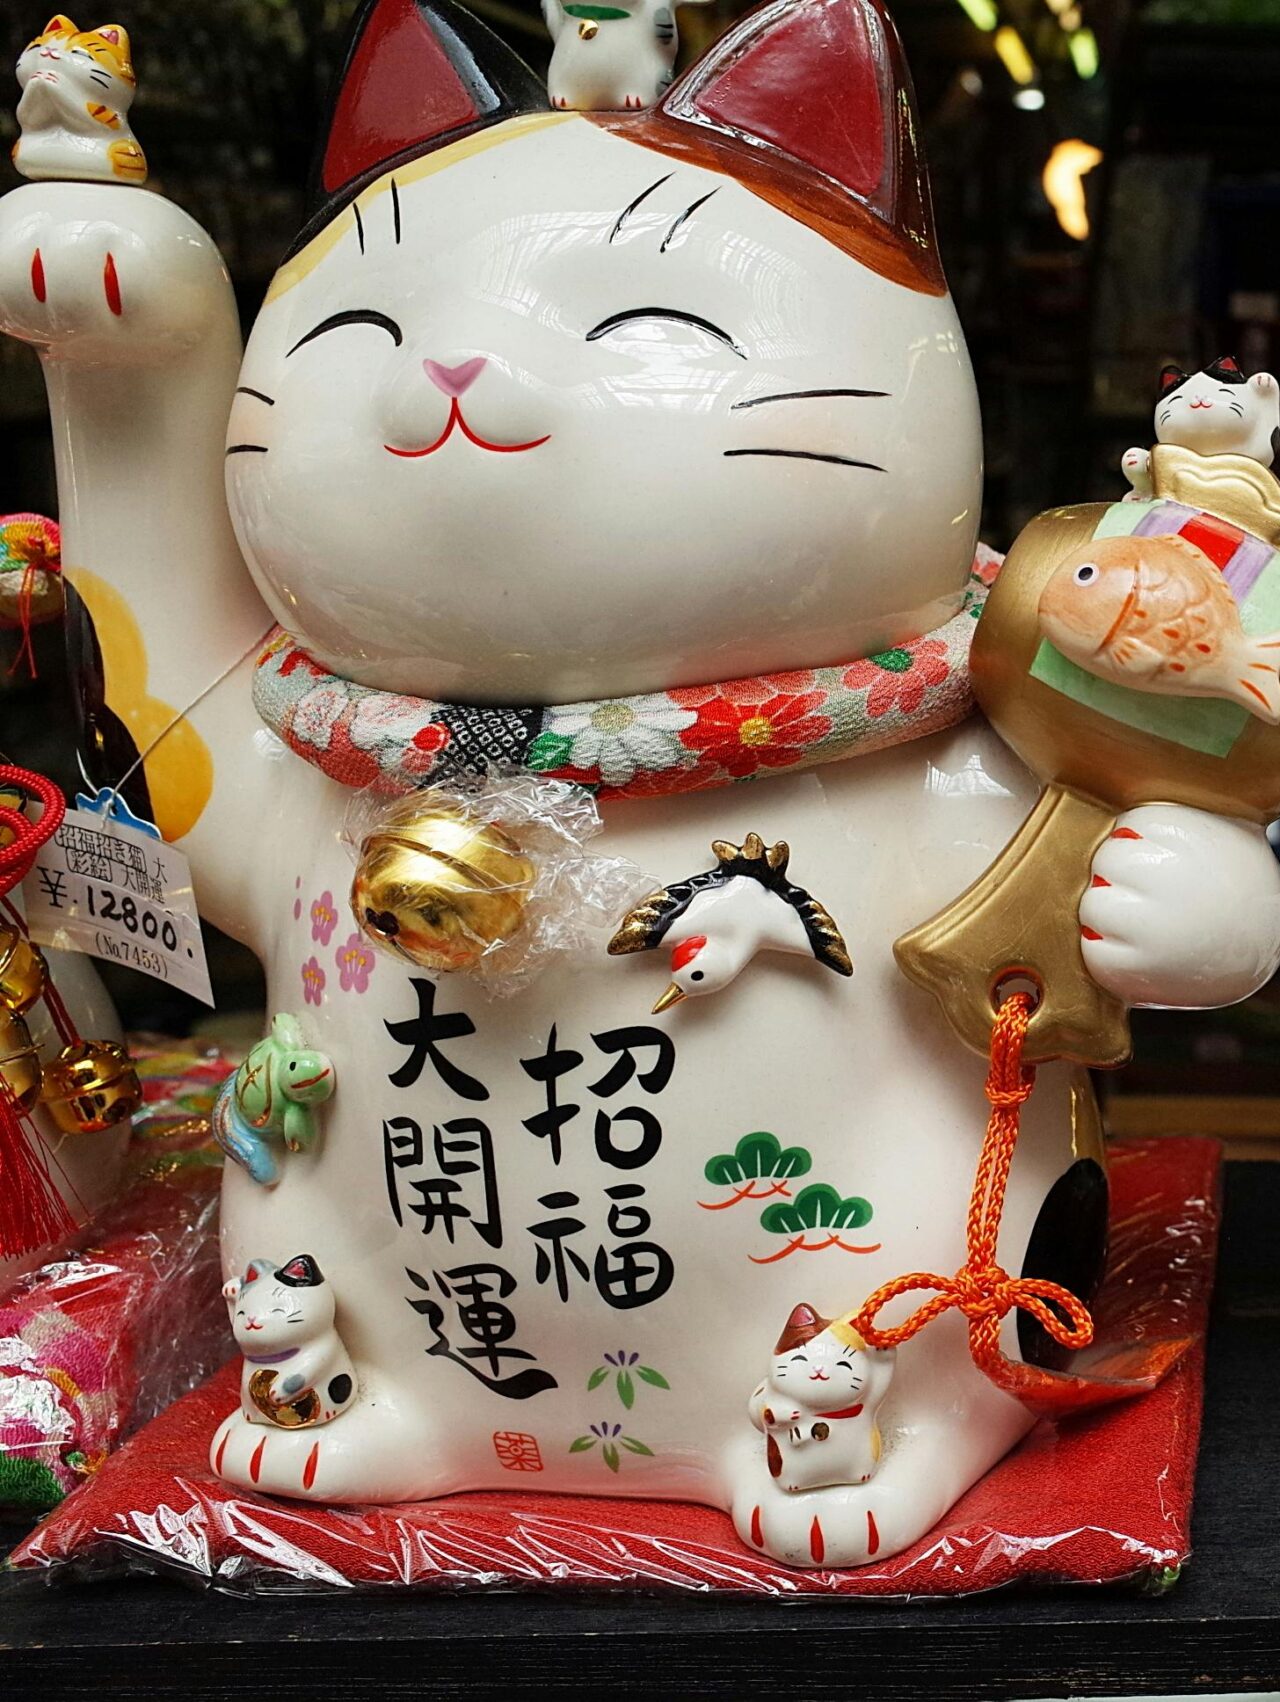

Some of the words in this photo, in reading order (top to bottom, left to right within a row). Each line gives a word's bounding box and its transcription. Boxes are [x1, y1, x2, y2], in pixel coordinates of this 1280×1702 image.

[58, 825, 145, 873] 招福招き猫
[153, 857, 167, 883] 大
[71, 850, 109, 881] 彩絵
[121, 864, 165, 904] 大開運
[382, 977, 559, 1400] 大開運
[519, 1021, 676, 1310] 招福
